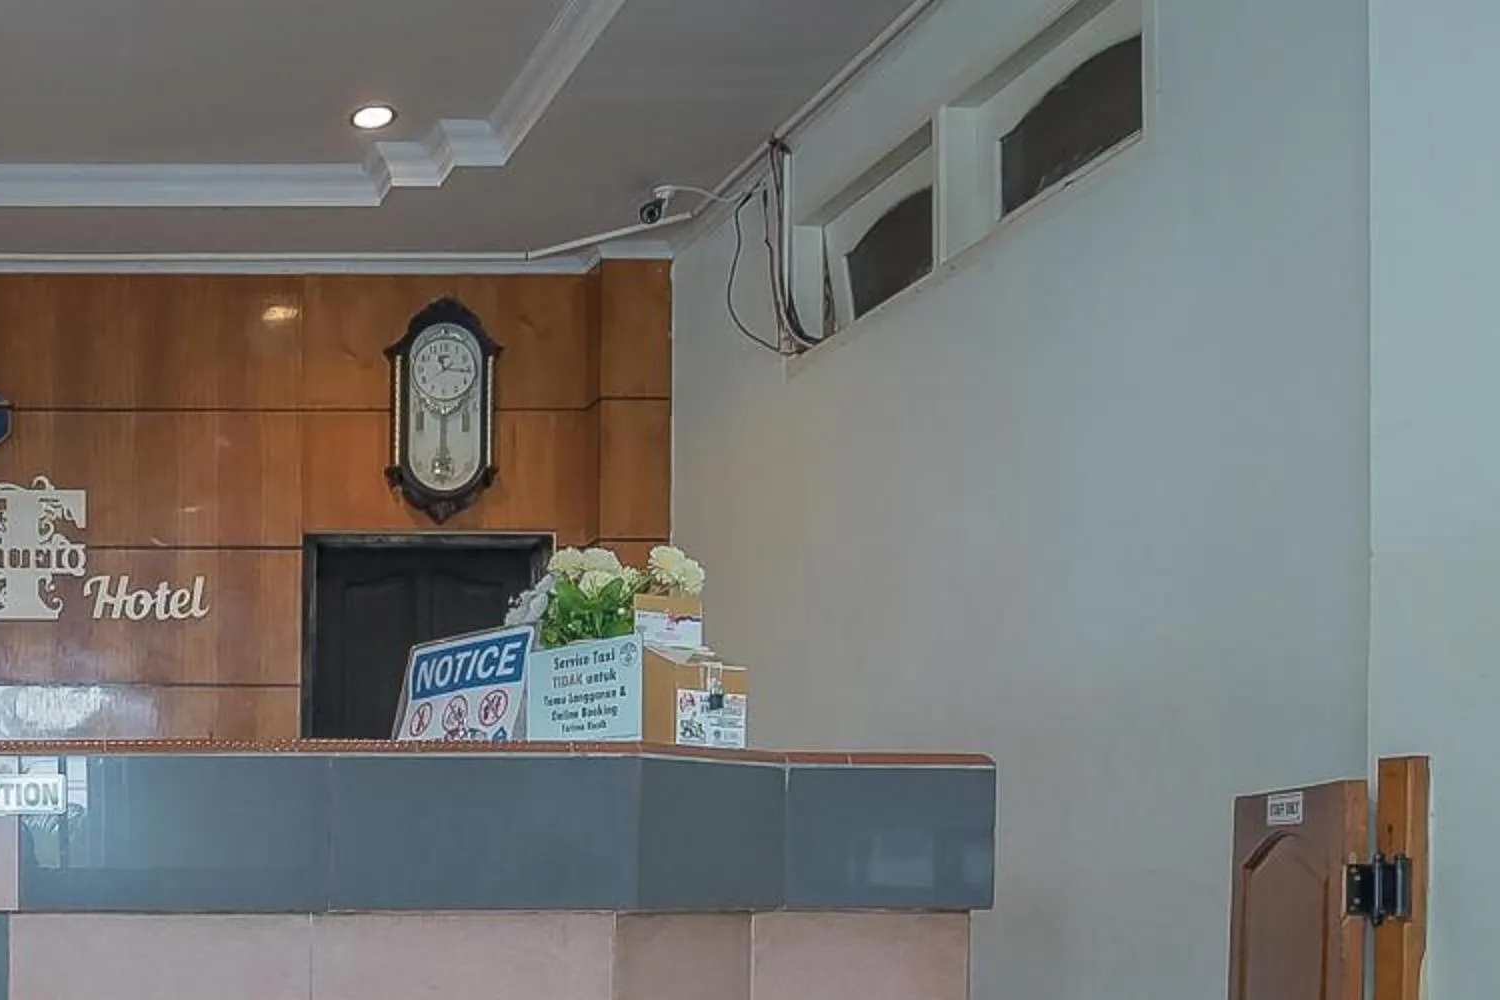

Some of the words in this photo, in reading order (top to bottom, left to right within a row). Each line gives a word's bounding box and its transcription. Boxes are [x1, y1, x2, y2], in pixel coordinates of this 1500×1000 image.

[83, 574, 211, 621] Hotel
[416, 641, 522, 693] NOTICE
[552, 672, 583, 688] TIDAK
[585, 667, 617, 684] untuk
[553, 652, 590, 670] Service
